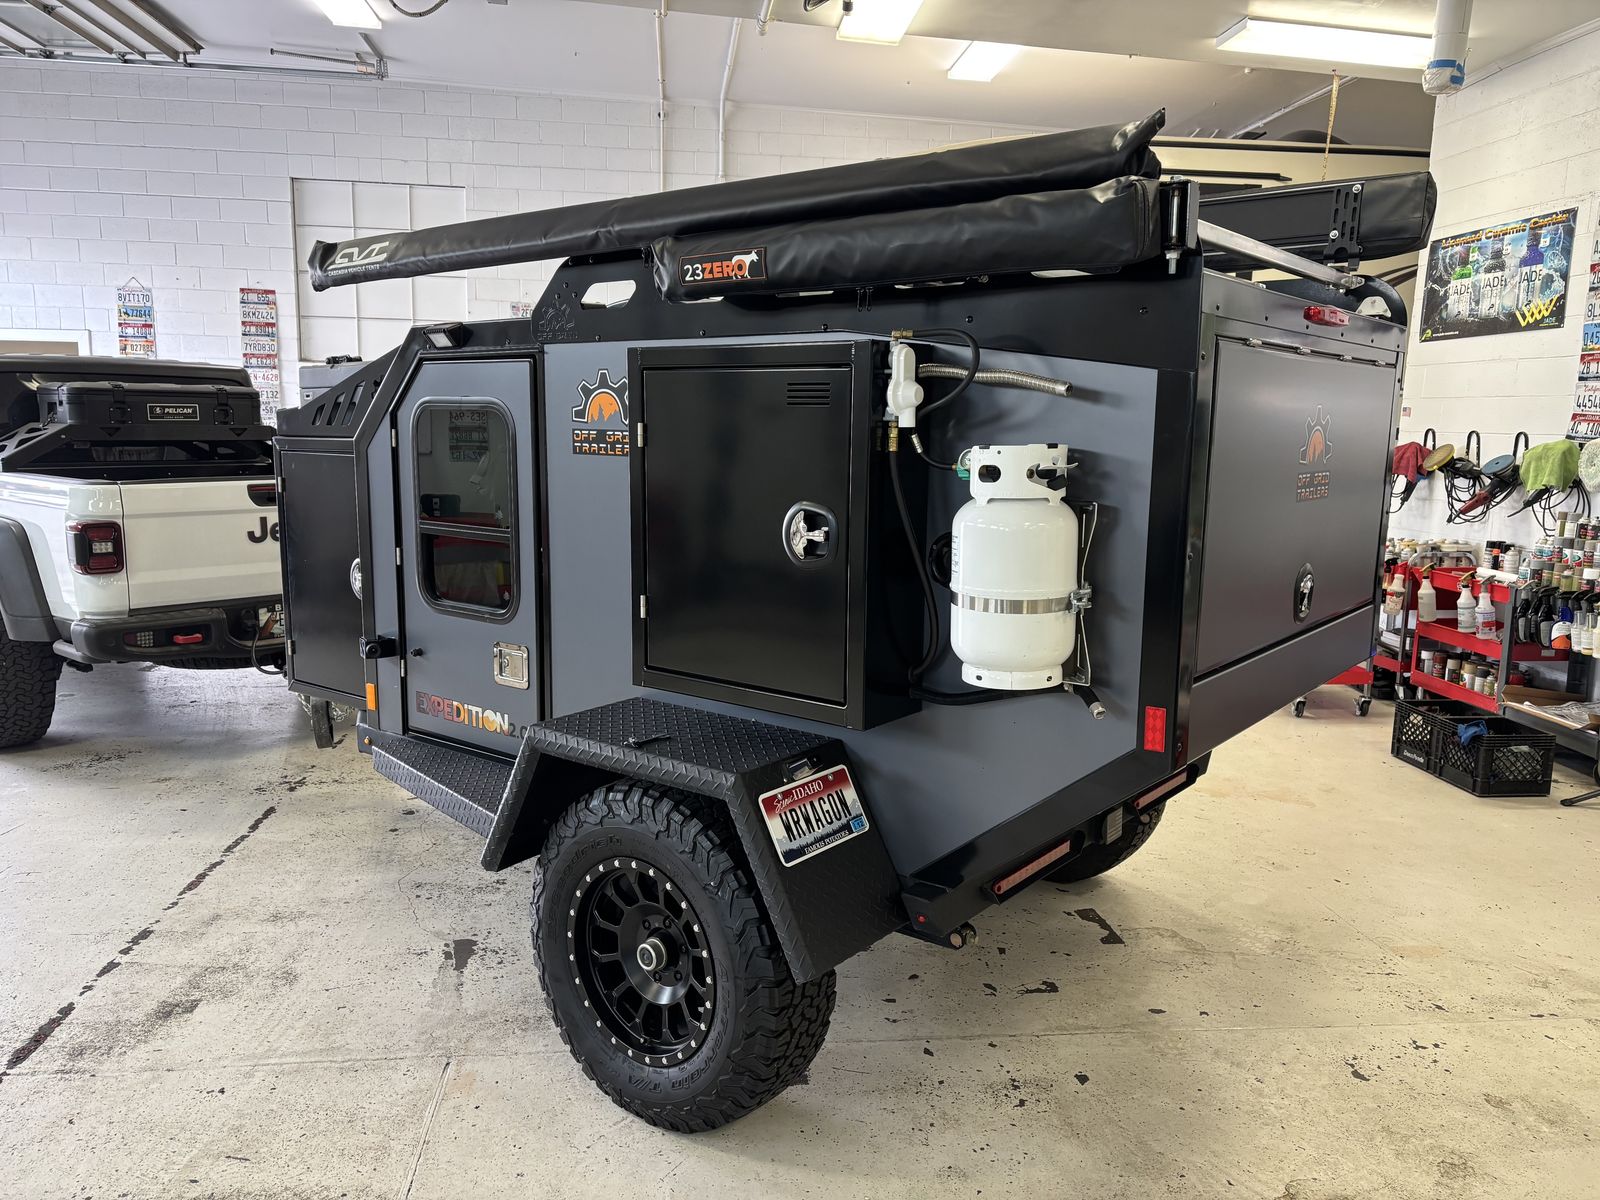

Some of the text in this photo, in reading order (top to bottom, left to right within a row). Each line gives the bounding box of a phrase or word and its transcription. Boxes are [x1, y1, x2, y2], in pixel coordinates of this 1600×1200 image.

[683, 258, 747, 281] 23ZERO
[1482, 275, 1505, 290] JADE
[242, 310, 274, 320] 8KMZ424
[573, 430, 630, 443] OFF GRI
[573, 442, 630, 455] TRAILER
[1298, 474, 1311, 487] OFF
[415, 690, 510, 737] EXPEDITION
[792, 779, 824, 801] IDAHO
[779, 788, 852, 843] WRWAGON
[804, 840, 825, 855] FAMOUS
